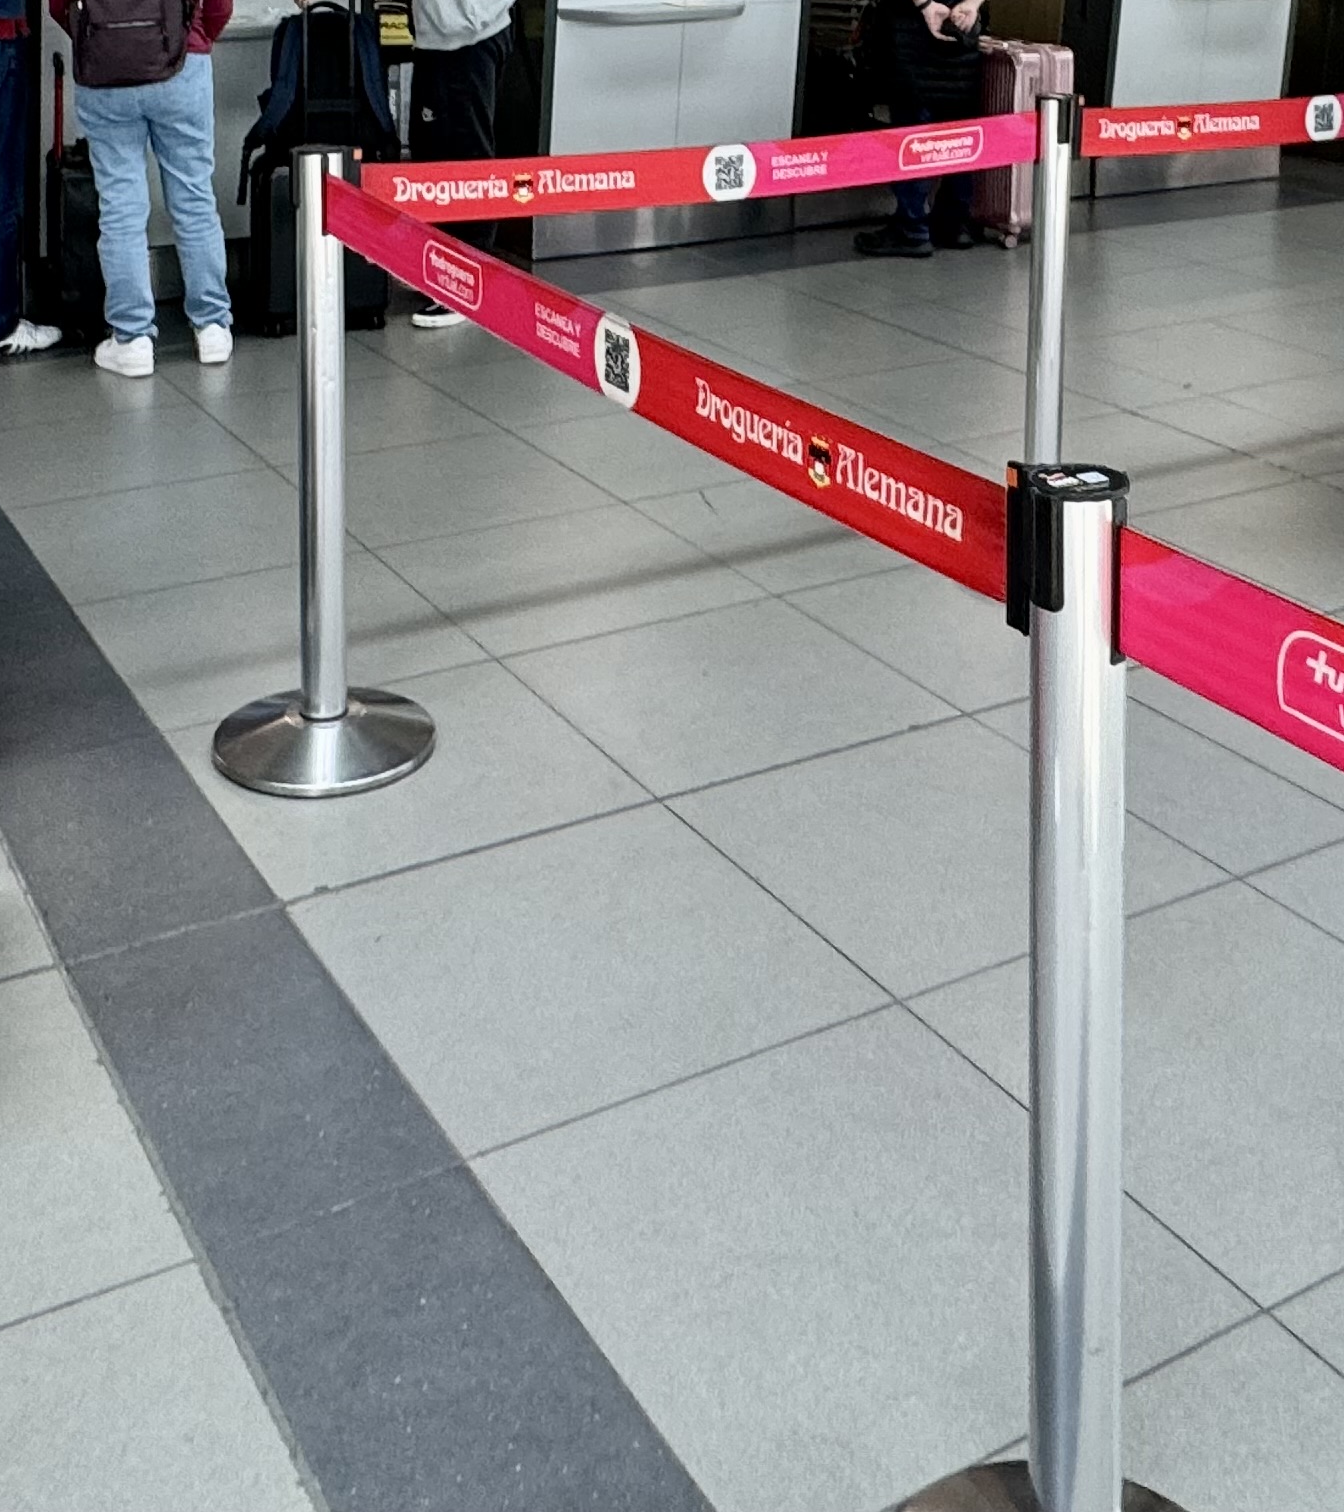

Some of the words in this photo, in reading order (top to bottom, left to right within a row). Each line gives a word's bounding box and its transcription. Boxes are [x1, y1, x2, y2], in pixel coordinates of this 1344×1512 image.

[1193, 112, 1260, 135] Alemana
[771, 153, 819, 168] ESCANEA
[820, 151, 829, 162] Y
[537, 168, 636, 194] Alemana
[772, 164, 828, 180] DESCUBRE
[835, 442, 964, 543] Alemana
